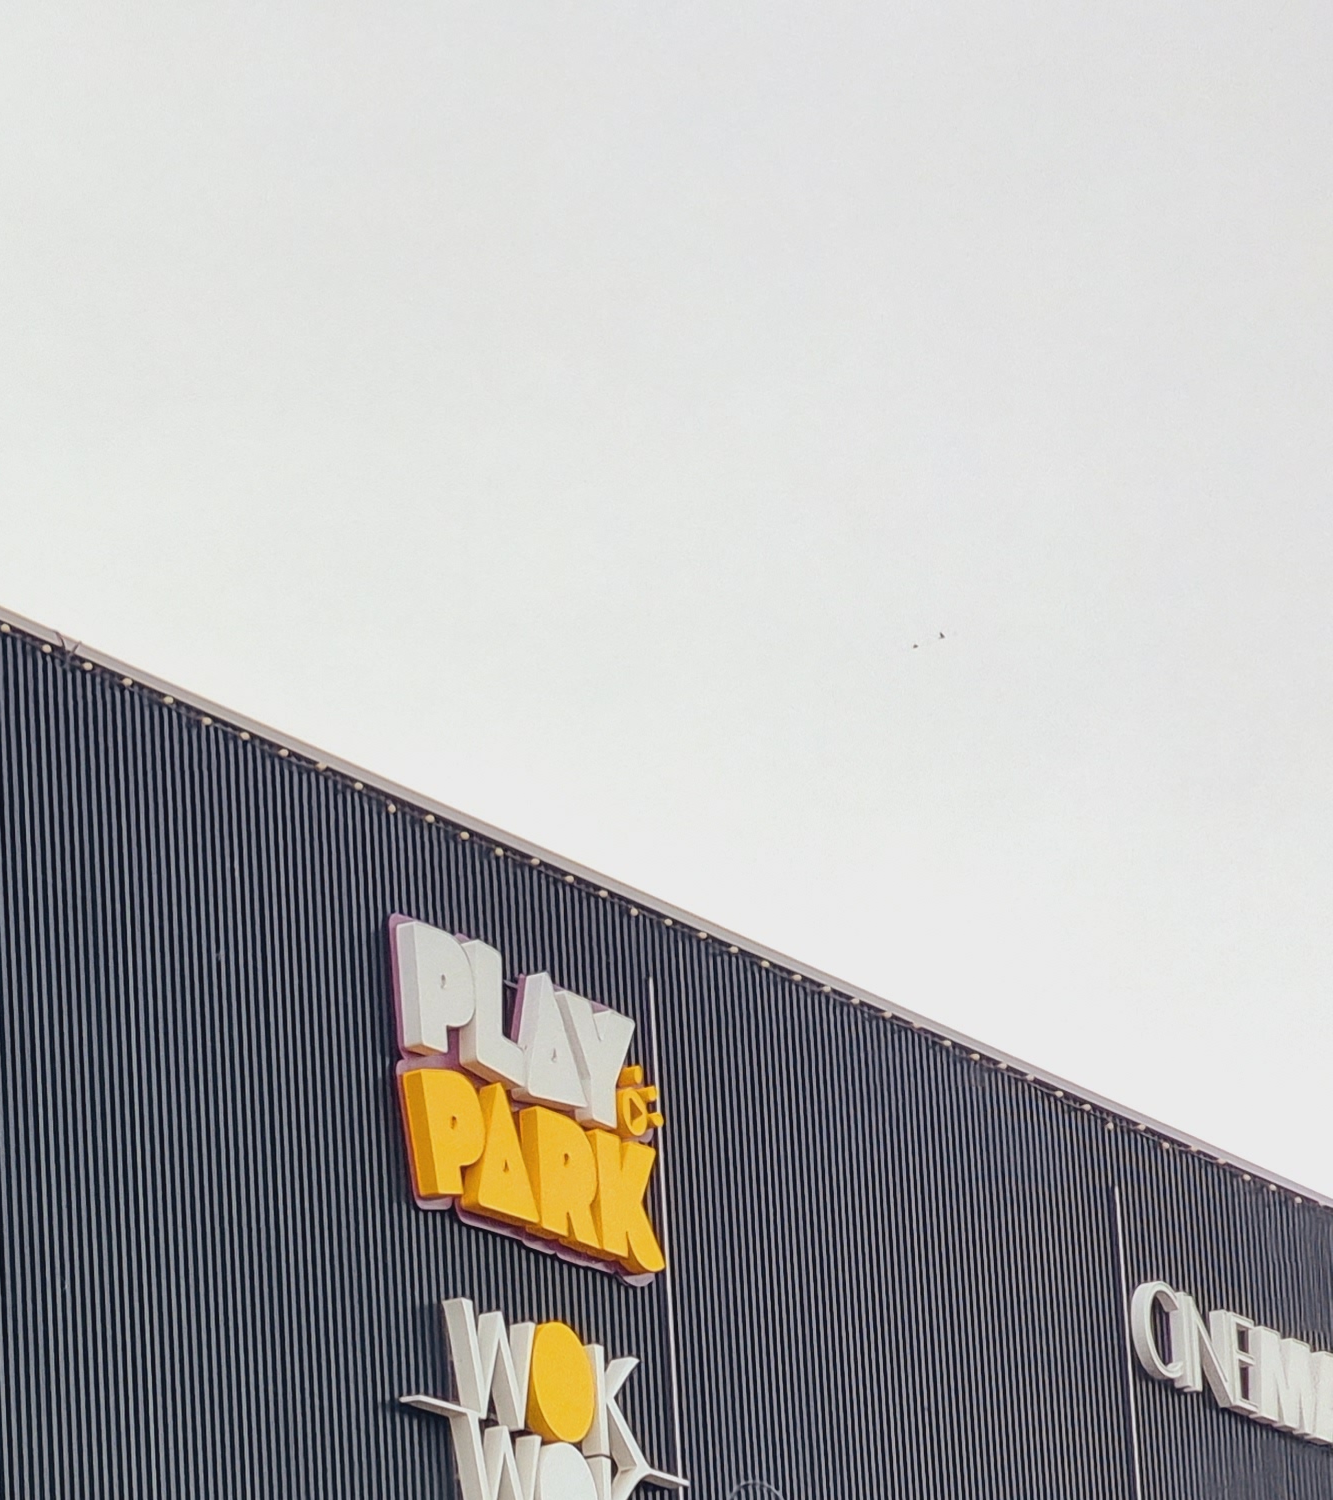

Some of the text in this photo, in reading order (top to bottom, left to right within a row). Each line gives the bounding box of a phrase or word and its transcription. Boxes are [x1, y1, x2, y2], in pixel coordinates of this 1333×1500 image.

[395, 921, 635, 1130] PLAY
[401, 1068, 666, 1274] PARK
[442, 1297, 641, 1458] WOK
[1131, 1281, 1333, 1446] CINEM
